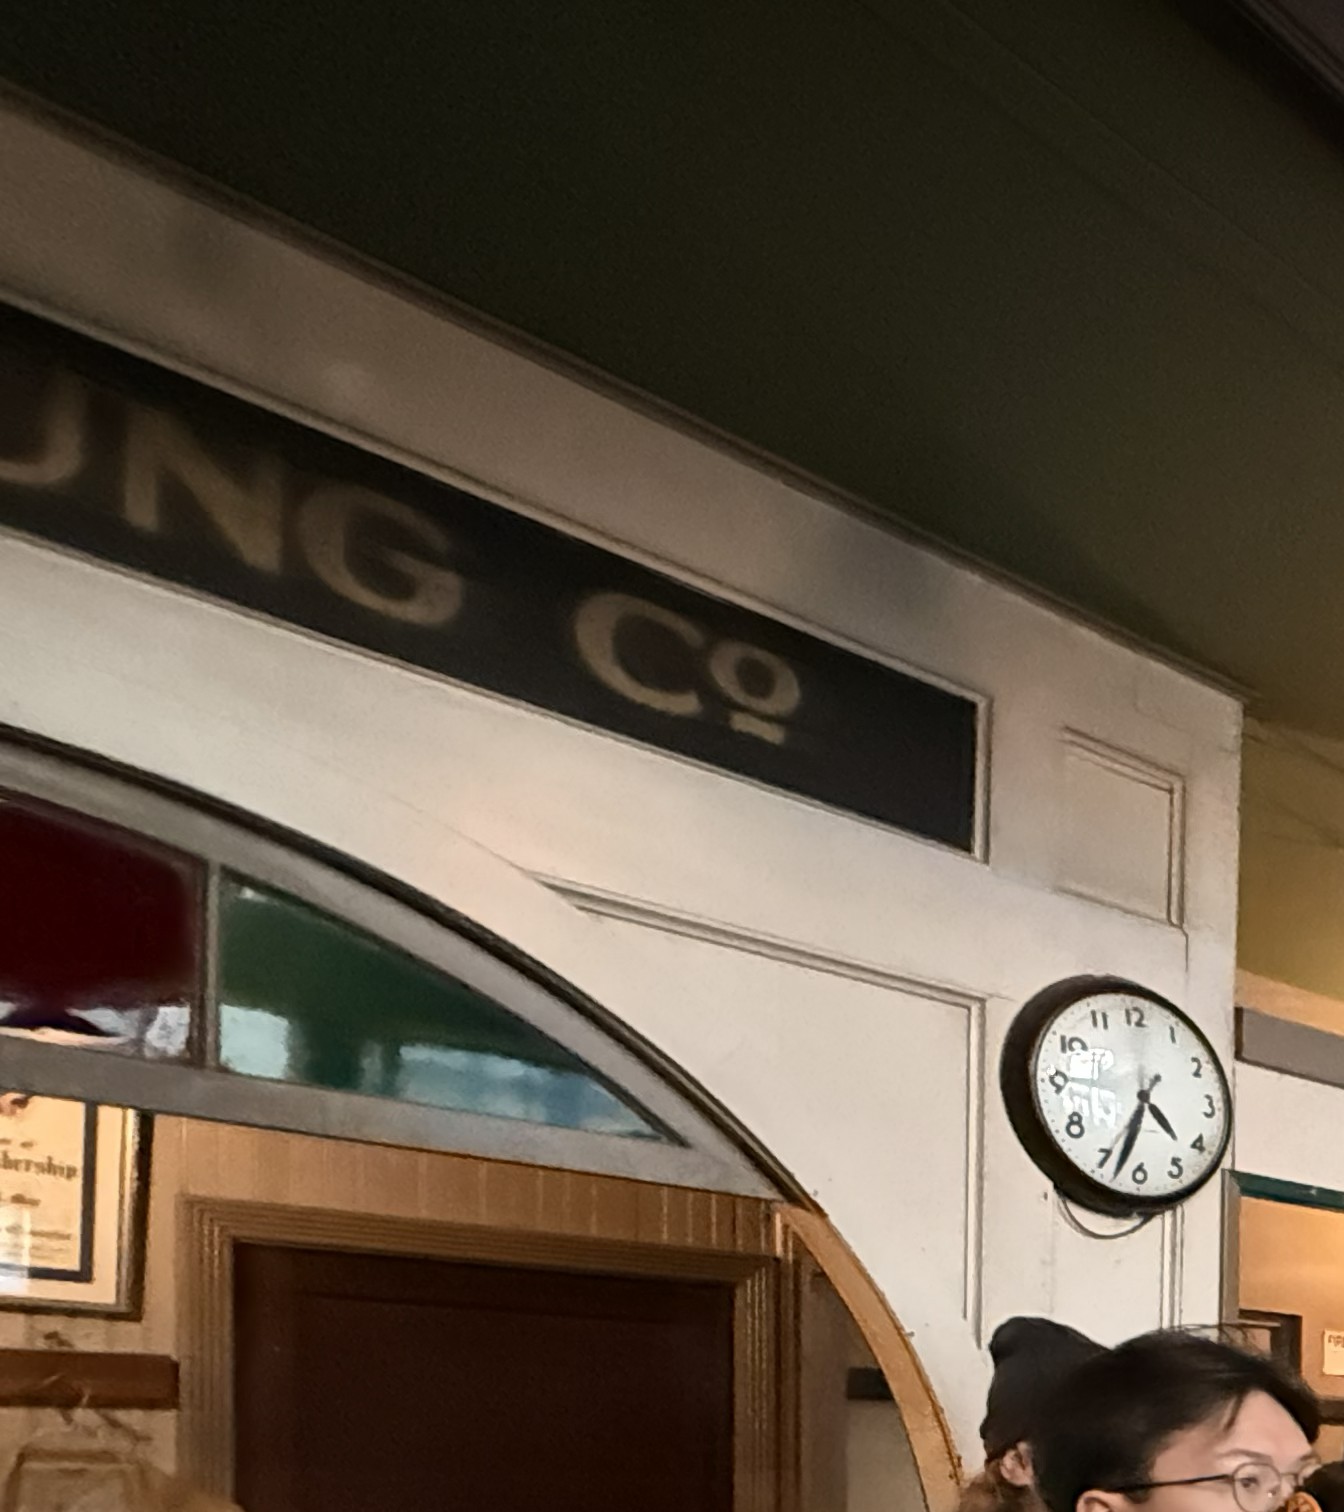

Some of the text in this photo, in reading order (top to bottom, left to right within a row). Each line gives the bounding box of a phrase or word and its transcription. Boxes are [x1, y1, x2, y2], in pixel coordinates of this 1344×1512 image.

[1090, 1008, 1109, 1030] 11
[1124, 1006, 1148, 1028] 12
[1059, 1034, 1088, 1054] 10
[1168, 1025, 1177, 1044] 1
[1191, 1057, 1204, 1079] 2
[1048, 1069, 1070, 1096] 9
[1202, 1094, 1216, 1119] 3
[1065, 1111, 1086, 1140] 8
[1189, 1133, 1206, 1153] 4
[1096, 1147, 1113, 1170] 7
[1167, 1157, 1184, 1181] 5
[1131, 1162, 1149, 1186] 6
